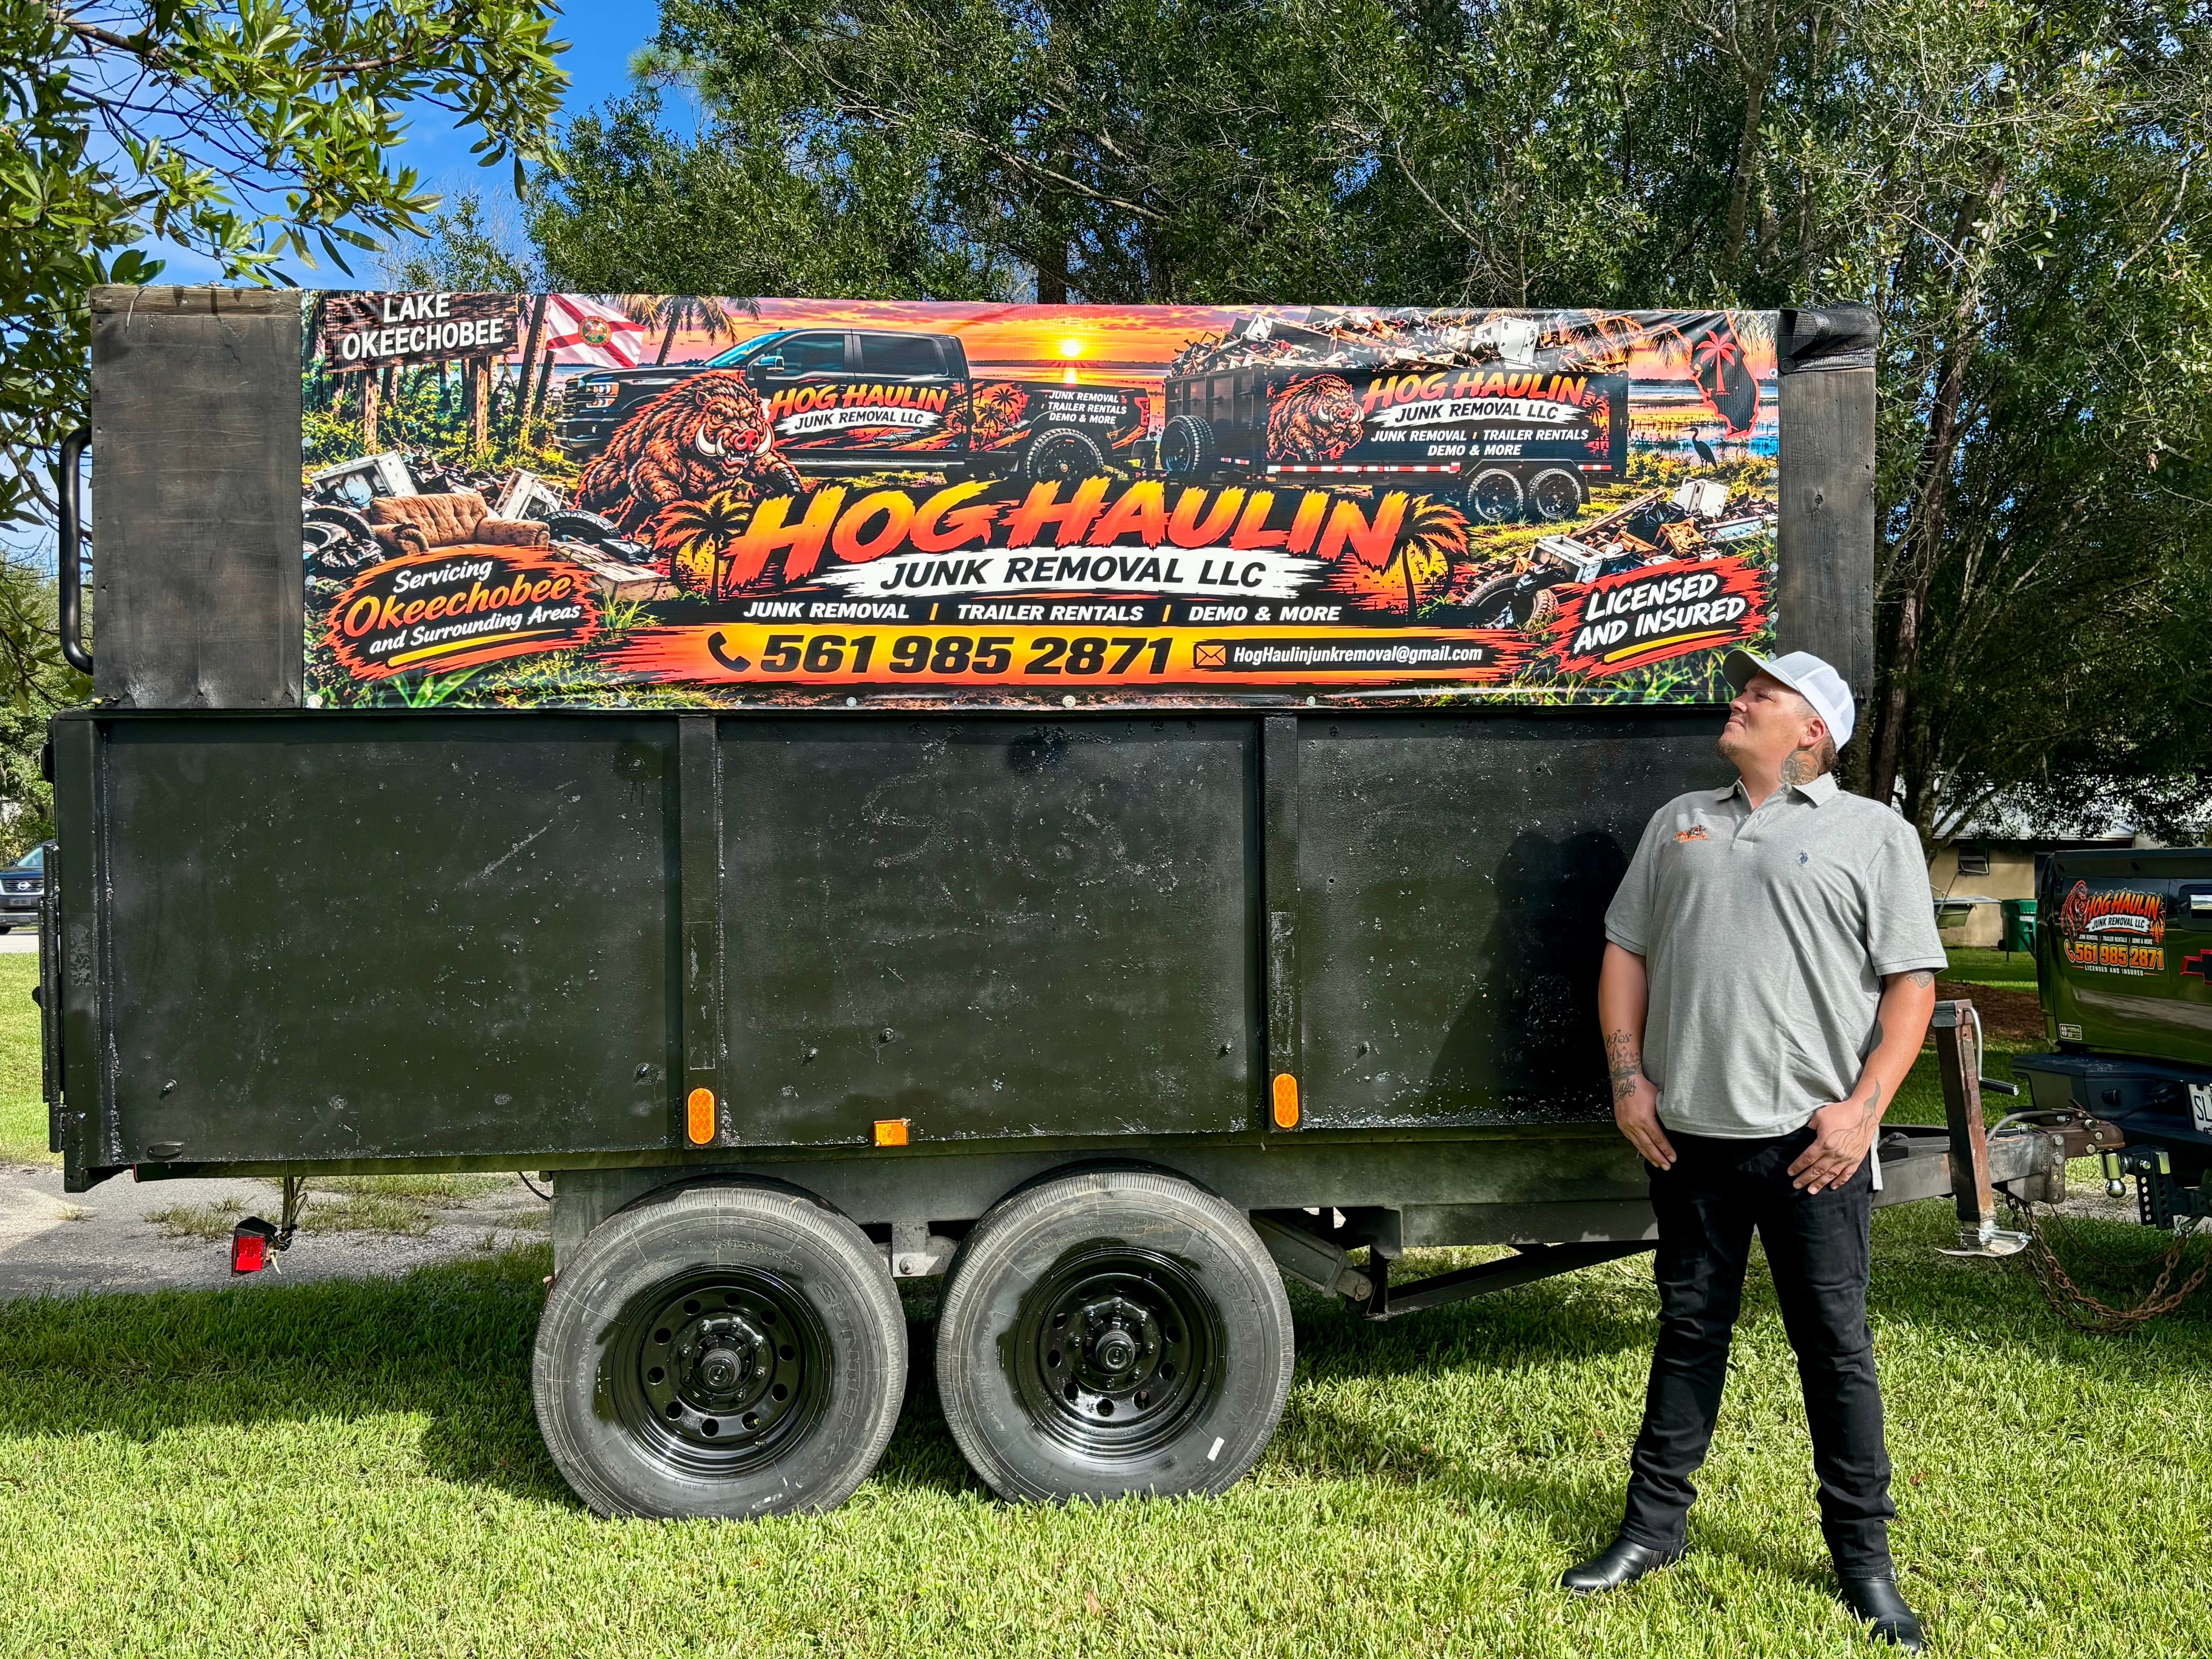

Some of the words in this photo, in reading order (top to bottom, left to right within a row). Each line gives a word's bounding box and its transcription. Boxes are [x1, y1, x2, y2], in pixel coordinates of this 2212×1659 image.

[384, 294, 451, 323] LAKE
[342, 318, 504, 360] OKEECHOBEE
[768, 388, 836, 421] HOG
[841, 385, 949, 412] HAULIN
[1048, 390, 1073, 402] JUNK
[1075, 392, 1119, 403] REMOVAL
[1363, 372, 1448, 414] HOG
[1453, 373, 1586, 403] HAULIN
[794, 414, 834, 430] JUNK
[838, 412, 897, 426] REMOVAL
[900, 412, 924, 425] LLC
[1048, 401, 1085, 413] TRAILER
[1088, 404, 1127, 415] RENTALS
[1049, 412, 1078, 423] DEMO
[1080, 414, 1088, 423] &
[1090, 414, 1116, 425] MORE
[1395, 404, 1442, 422] JUNK
[1448, 403, 1521, 419] REMOVAL
[1526, 405, 1559, 421] LLC
[1370, 430, 1407, 442] JUNK
[1410, 430, 1468, 442] REMOVAL
[1483, 429, 1533, 441] TRAILER
[1536, 429, 1589, 441] RENTALS
[1427, 444, 1466, 457] DEMO
[1469, 445, 1480, 456] &
[1484, 444, 1522, 457] MORE
[724, 480, 1005, 588] HOG
[1001, 476, 1411, 573] HAULIN
[393, 560, 494, 593] Servicing
[881, 558, 994, 590] JUNK
[1003, 556, 1183, 584] REMOVAL
[1198, 559, 1266, 588] LLC
[344, 574, 575, 637] Okeechobee
[744, 603, 806, 618] JUNK
[809, 603, 910, 619] REMOVAL
[957, 604, 1043, 620] TRAILER
[1050, 605, 1145, 621] RENTALS
[1188, 605, 1247, 622] DEMO
[1254, 607, 1272, 622] &
[1278, 607, 1342, 622] MORE
[1585, 574, 1719, 622] LICENSED
[369, 630, 408, 654] and
[409, 612, 523, 646] Surrounding
[527, 605, 581, 625] Areas
[1574, 620, 1628, 654] AND
[1635, 597, 1747, 638] INSURED
[760, 635, 878, 673] 561
[888, 635, 1013, 674] 985
[1023, 637, 1174, 675] 2871
[1233, 645, 1483, 666] HogHaulinjunkremoval@gmail.com
[2084, 892, 2113, 925] HOG
[2111, 888, 2162, 921] HAULIN
[2092, 918, 2107, 930] JUNK
[2108, 917, 2134, 927] REMOVAL
[2135, 918, 2145, 929] LLC
[2075, 942, 2098, 963] 561
[2100, 944, 2128, 966] 985
[2130, 946, 2164, 969] 2871
[2085, 964, 2108, 973] LICENSED
[2122, 967, 2144, 976] INSURED
